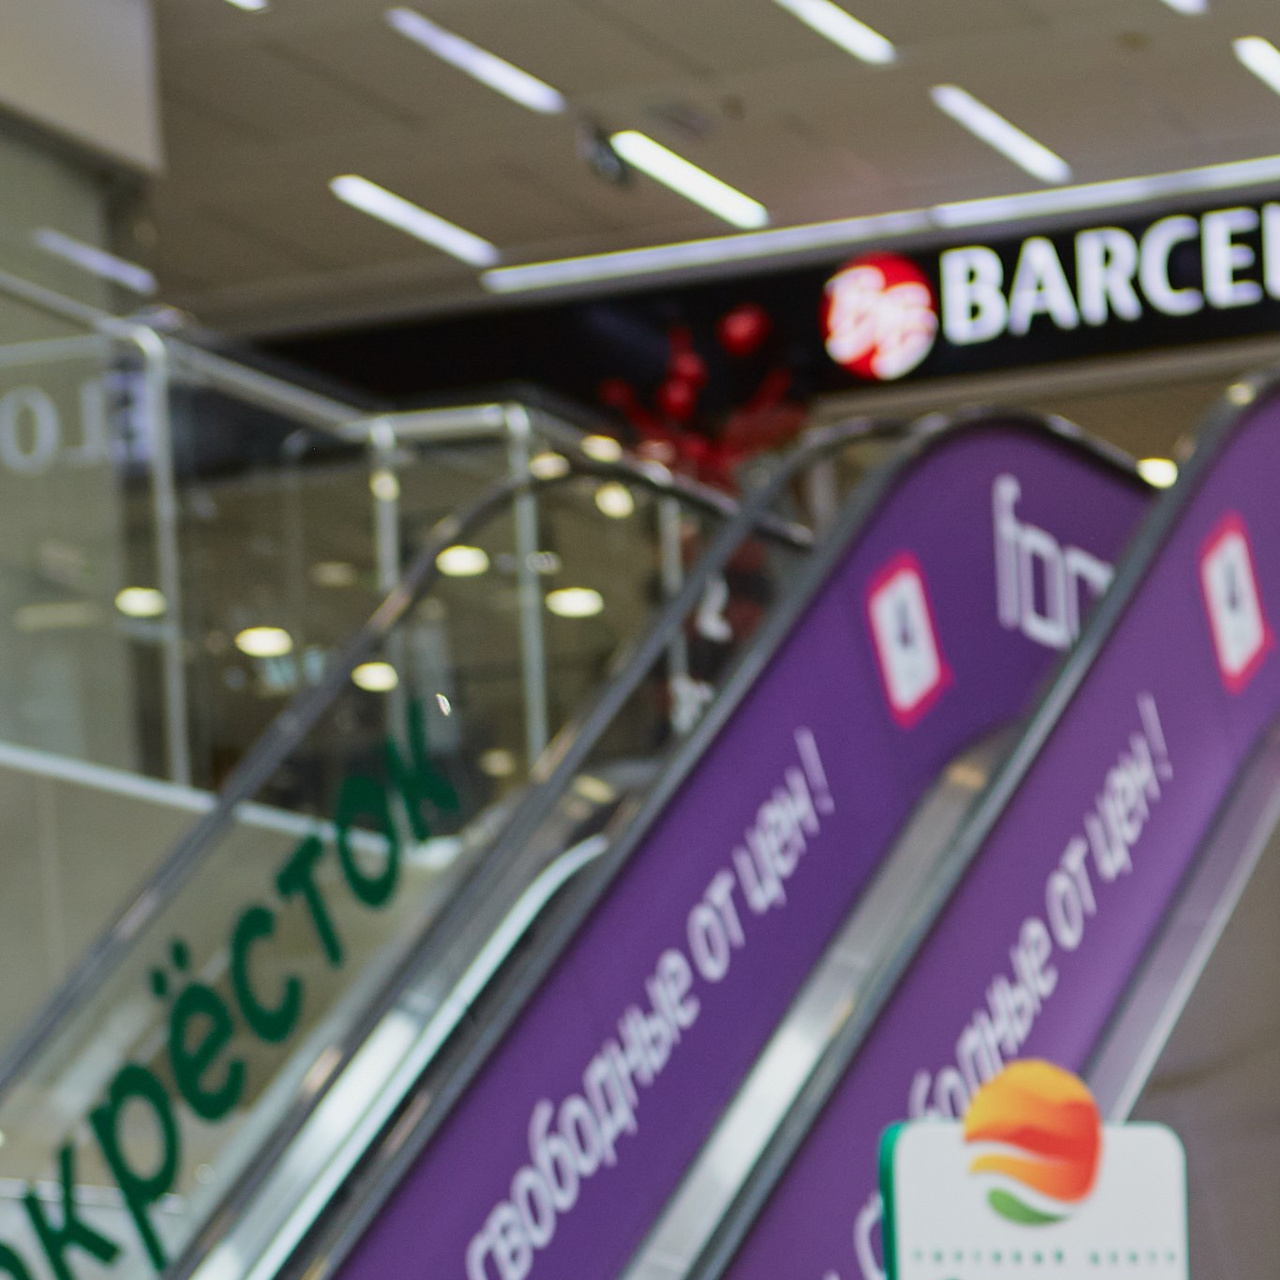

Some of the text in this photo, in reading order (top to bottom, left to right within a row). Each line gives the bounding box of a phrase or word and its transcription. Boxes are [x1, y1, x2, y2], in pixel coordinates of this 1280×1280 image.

[687, 869, 745, 983] от
[735, 728, 837, 912] цен!
[1044, 835, 1098, 952] от
[1085, 691, 1174, 881] цен!
